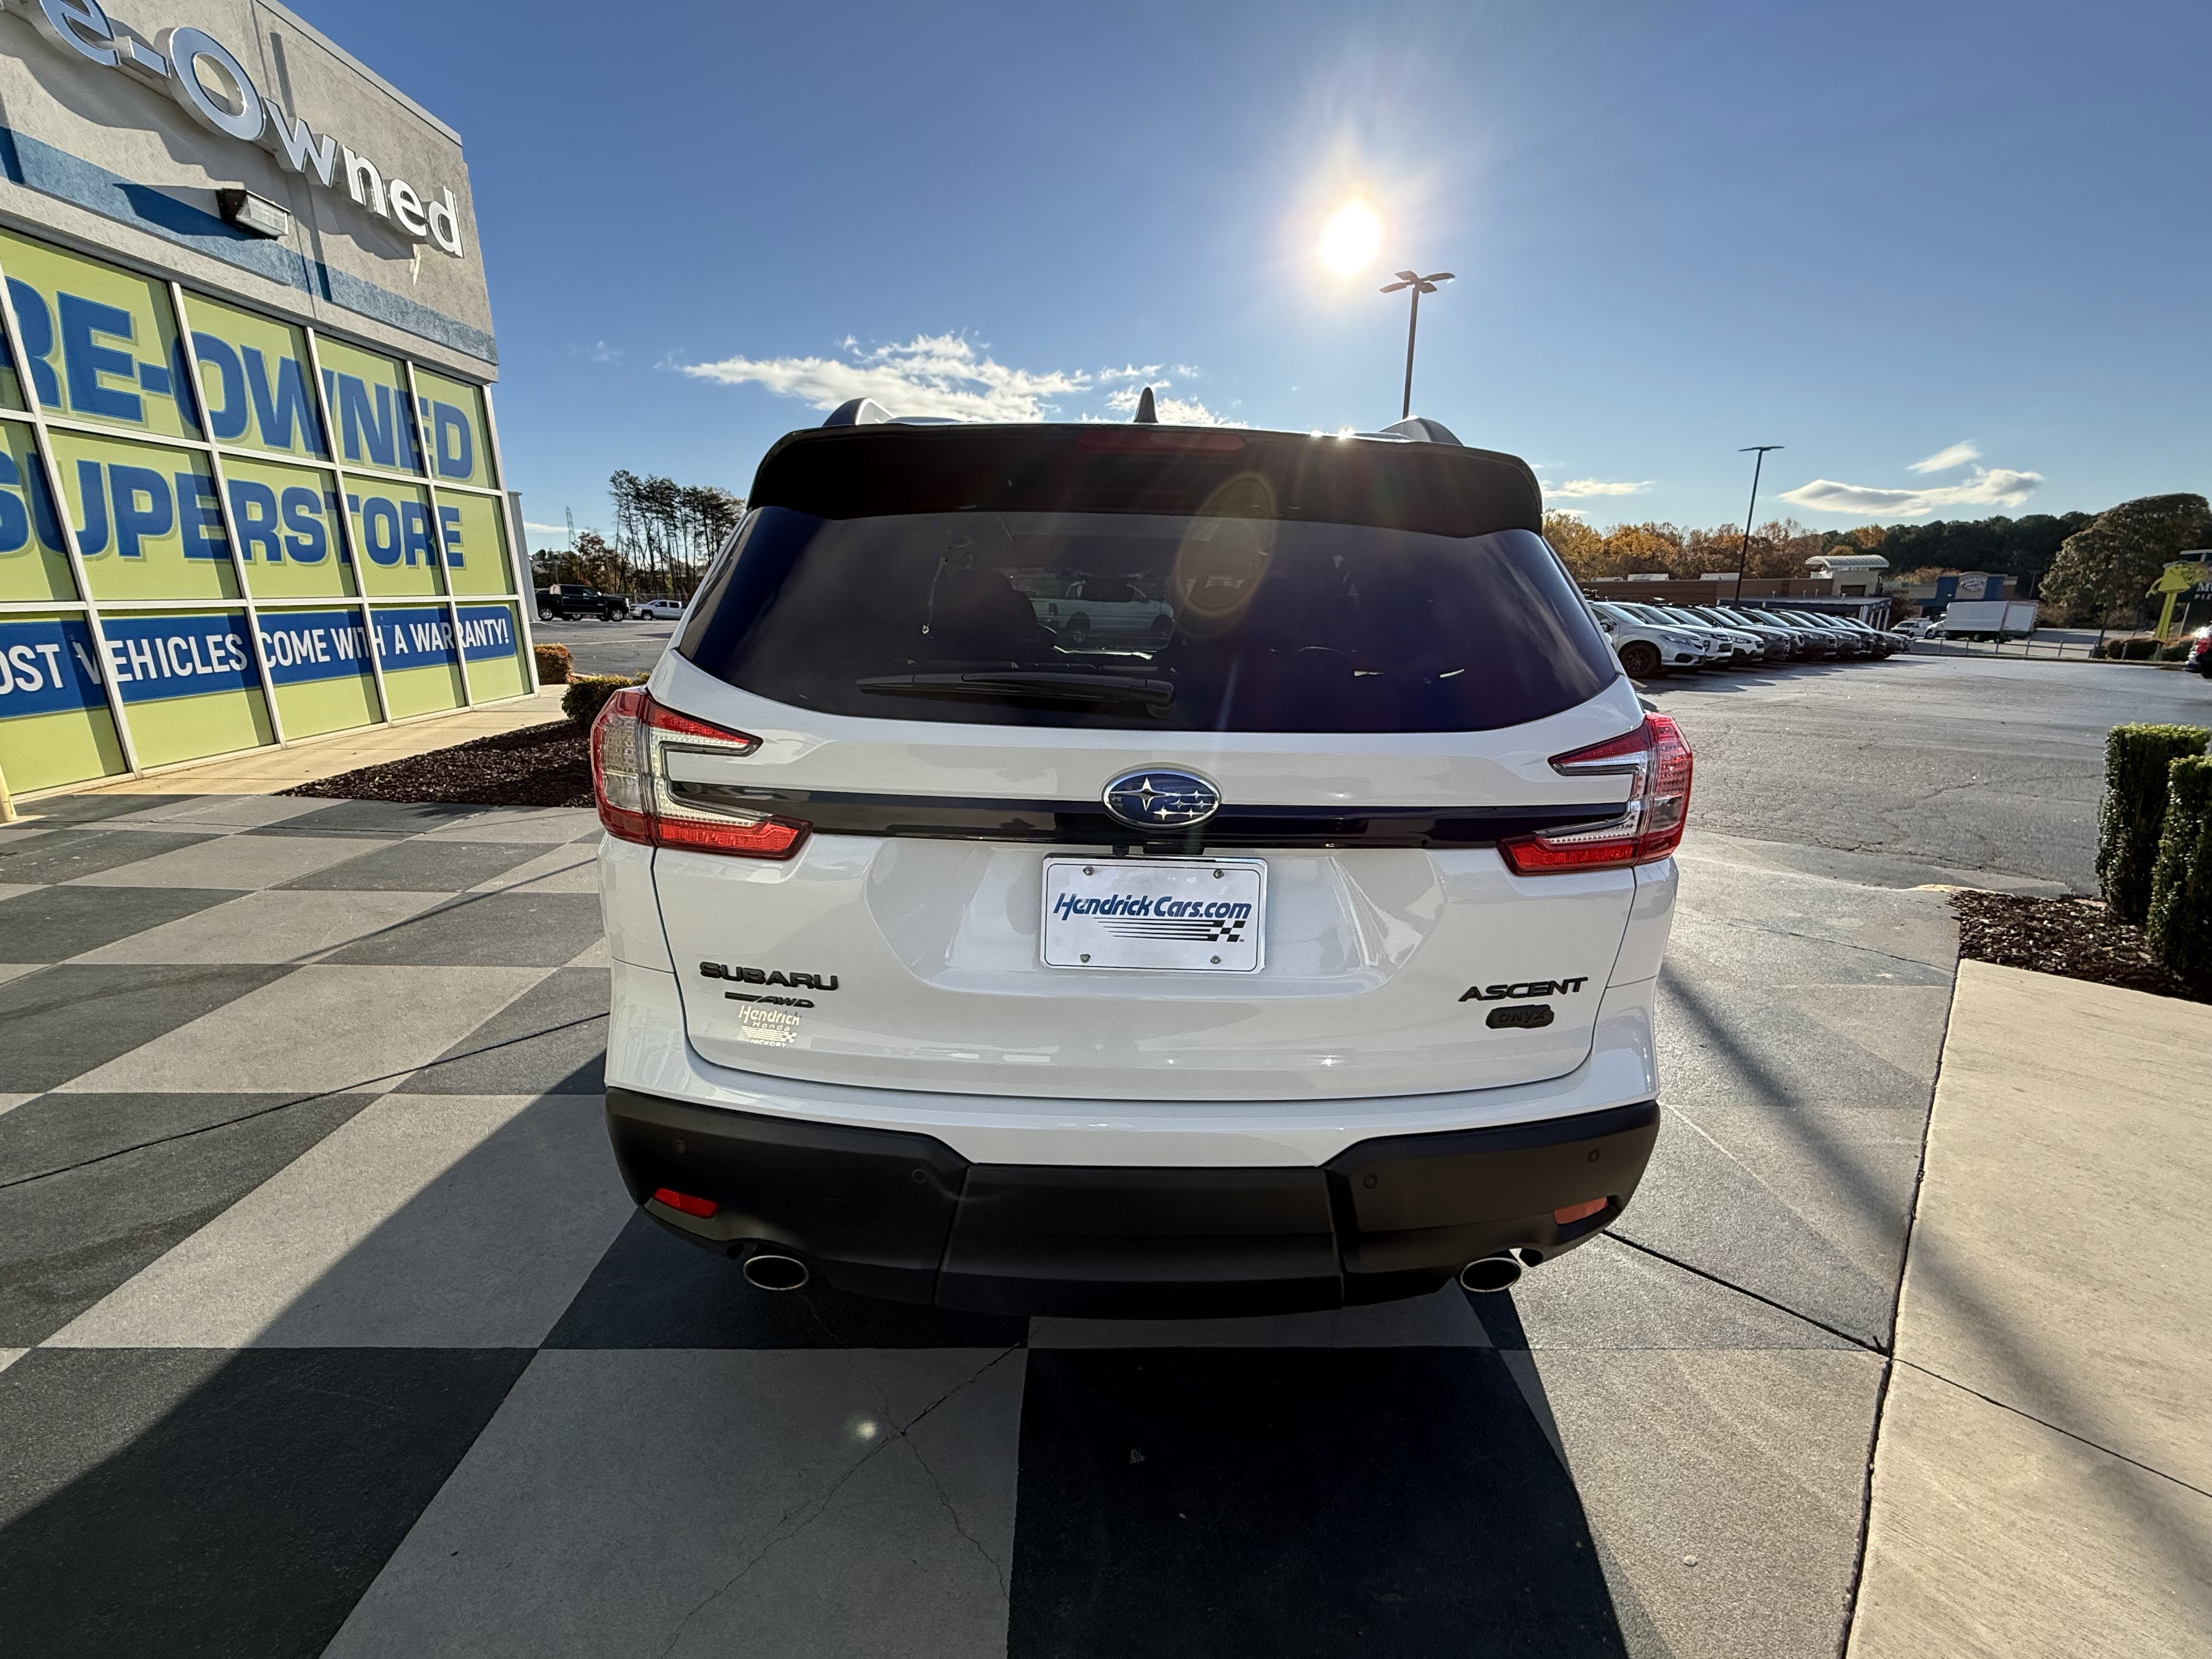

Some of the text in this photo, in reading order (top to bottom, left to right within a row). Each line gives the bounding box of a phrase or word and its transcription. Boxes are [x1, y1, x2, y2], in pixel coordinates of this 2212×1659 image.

[0, 0, 465, 258] e-Owned
[0, 274, 473, 479] RE-OWNED
[72, 634, 247, 684] VEHICLES
[259, 629, 330, 668] COME
[330, 625, 386, 660] WITH
[394, 624, 409, 654] A
[409, 618, 509, 652] WARRANTY!
[699, 962, 839, 991] SUBARU
[757, 996, 815, 1008] AWD
[1458, 977, 1588, 1002] ASCENT
[738, 1005, 800, 1025] Hendrick
[752, 1021, 791, 1031] Honda
[1498, 1009, 1547, 1024] ONYX
